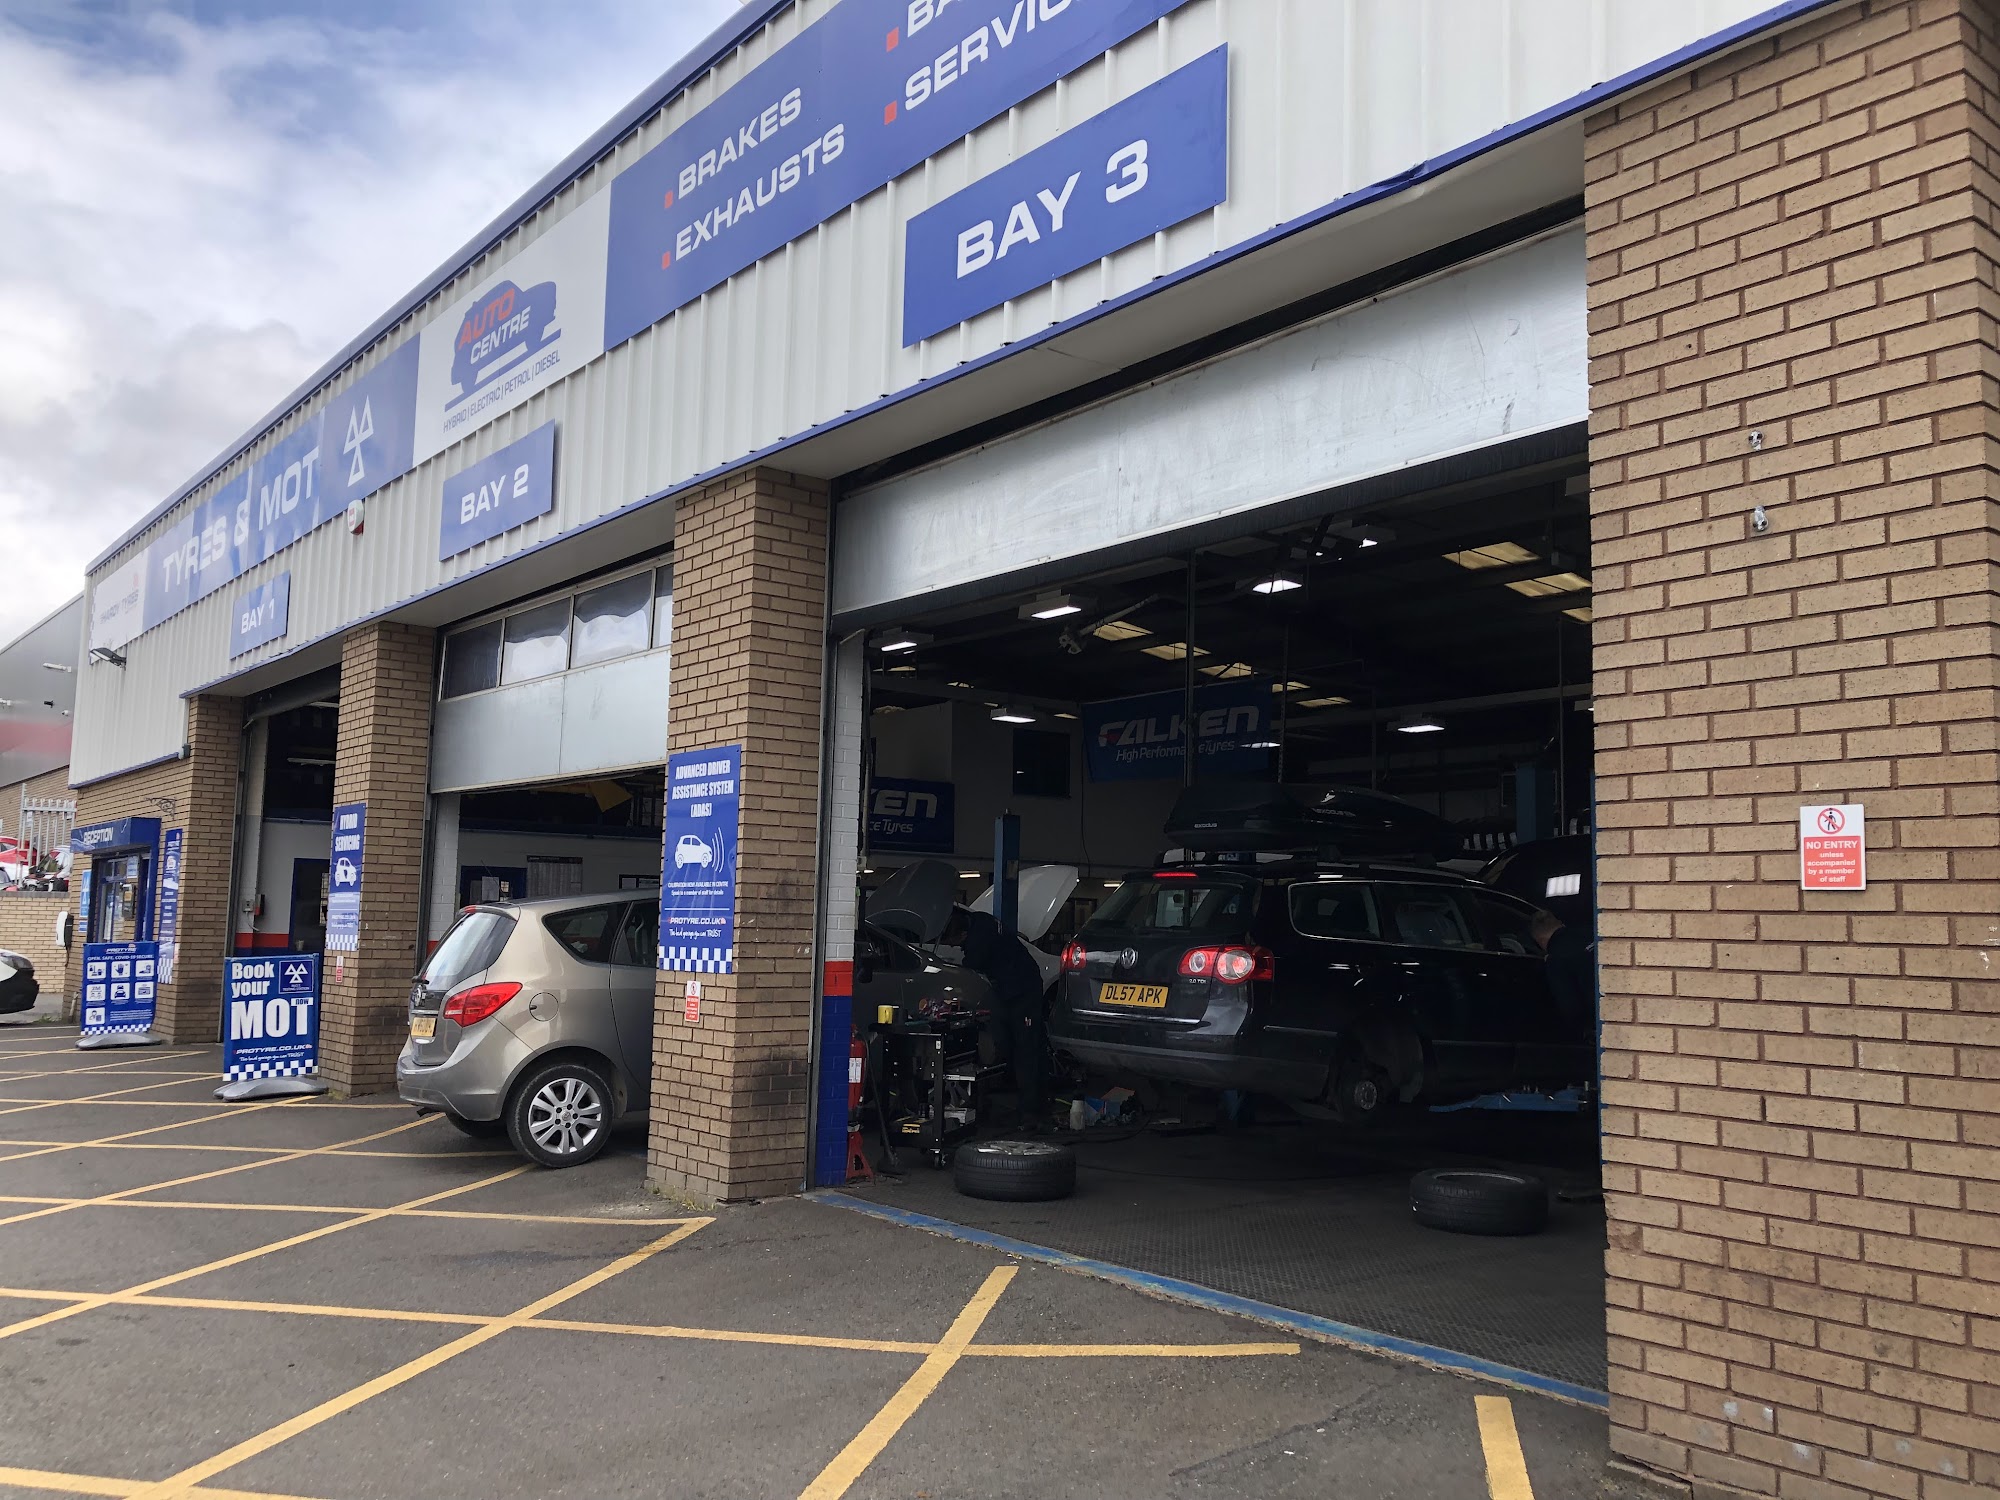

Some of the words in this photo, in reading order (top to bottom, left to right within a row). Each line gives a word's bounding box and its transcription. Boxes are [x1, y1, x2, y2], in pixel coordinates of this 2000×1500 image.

[678, 87, 802, 201] BRAKES
[674, 124, 844, 261] EXHAUSTS
[957, 171, 1081, 280] BAY
[1105, 139, 1148, 204] 3
[458, 288, 515, 349] AUTO
[471, 306, 531, 365] CENTRE
[443, 410, 467, 433] HYBRID
[471, 387, 501, 416] ELECTRIC
[505, 370, 531, 395] PETROL
[535, 350, 561, 376] DIESEL
[460, 481, 503, 524] BAY
[514, 463, 529, 498] 2
[163, 516, 226, 592] TYRES
[234, 499, 249, 546] &
[259, 446, 319, 531] MOT
[241, 607, 264, 634] BAY
[268, 598, 275, 619] 1
[1116, 749, 1138, 763] High
[1205, 740, 1235, 755] Tyres
[675, 762, 707, 779] ADVANCED
[708, 760, 731, 776] DRIVER
[672, 783, 708, 800] ASSISTANCE
[709, 780, 734, 796] SYSTEM
[84, 827, 113, 845] RECEPTION
[882, 819, 913, 835] Tyres
[1824, 841, 1858, 849] ENTRY
[1807, 859, 1856, 867] accompanied
[670, 917, 721, 925] PROTYRE.CO.UK
[231, 961, 275, 979] Book
[231, 981, 270, 999] your
[1104, 983, 1135, 1001] DL57
[1137, 986, 1161, 1003] APK
[231, 997, 314, 1040] MOT
[236, 1045, 305, 1055] PROTYRE.CO.UK
